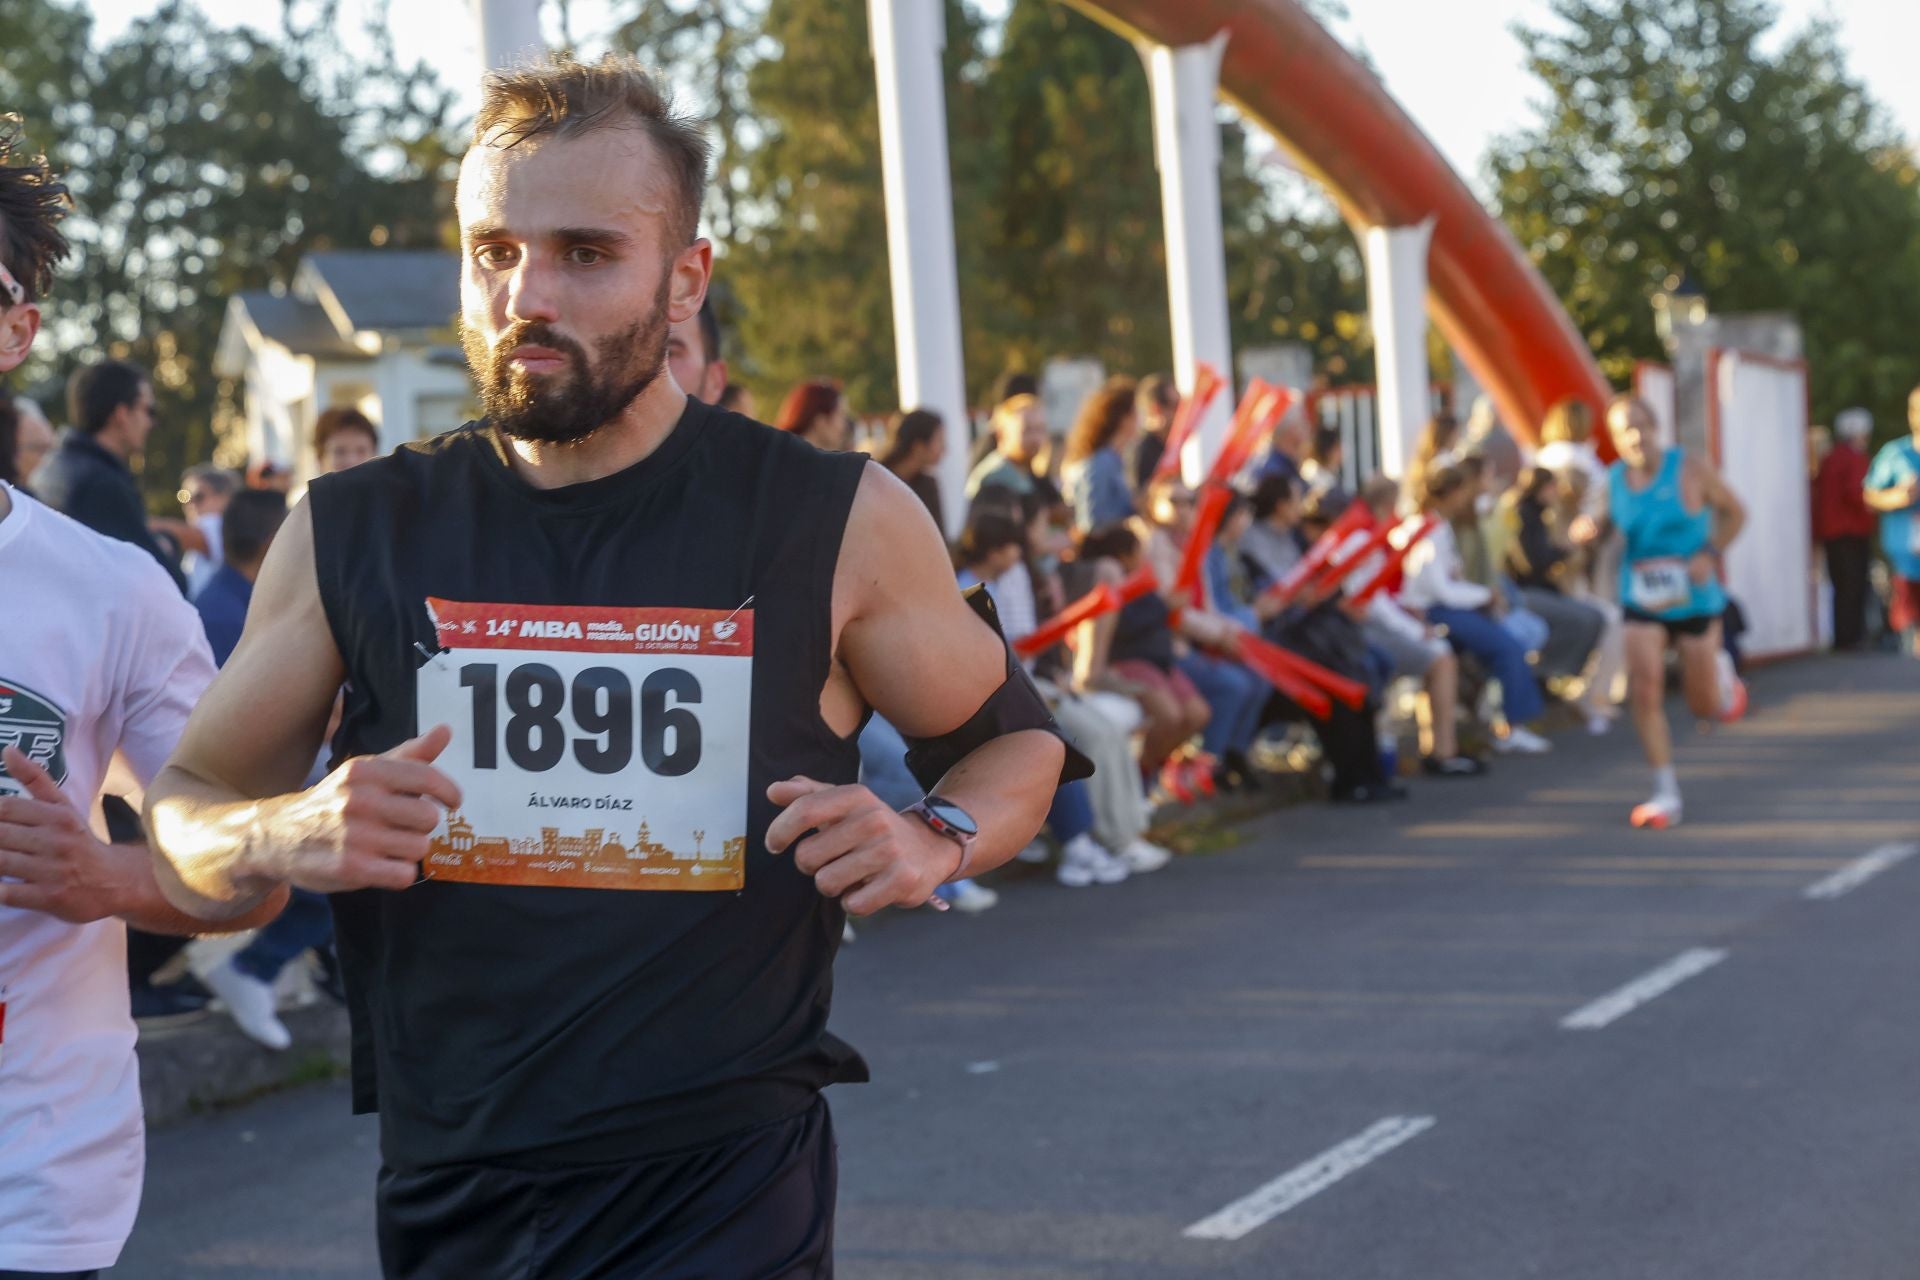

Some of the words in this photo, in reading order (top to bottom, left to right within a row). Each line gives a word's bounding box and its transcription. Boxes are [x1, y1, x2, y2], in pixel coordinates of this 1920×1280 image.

[519, 621, 583, 639] MBA
[587, 620, 623, 631] media
[635, 620, 701, 642] GIJÓN
[586, 630, 635, 641] maratón
[459, 662, 703, 777] 1896
[527, 792, 591, 810] ÁLVARO
[594, 793, 633, 811] DÍAZ
